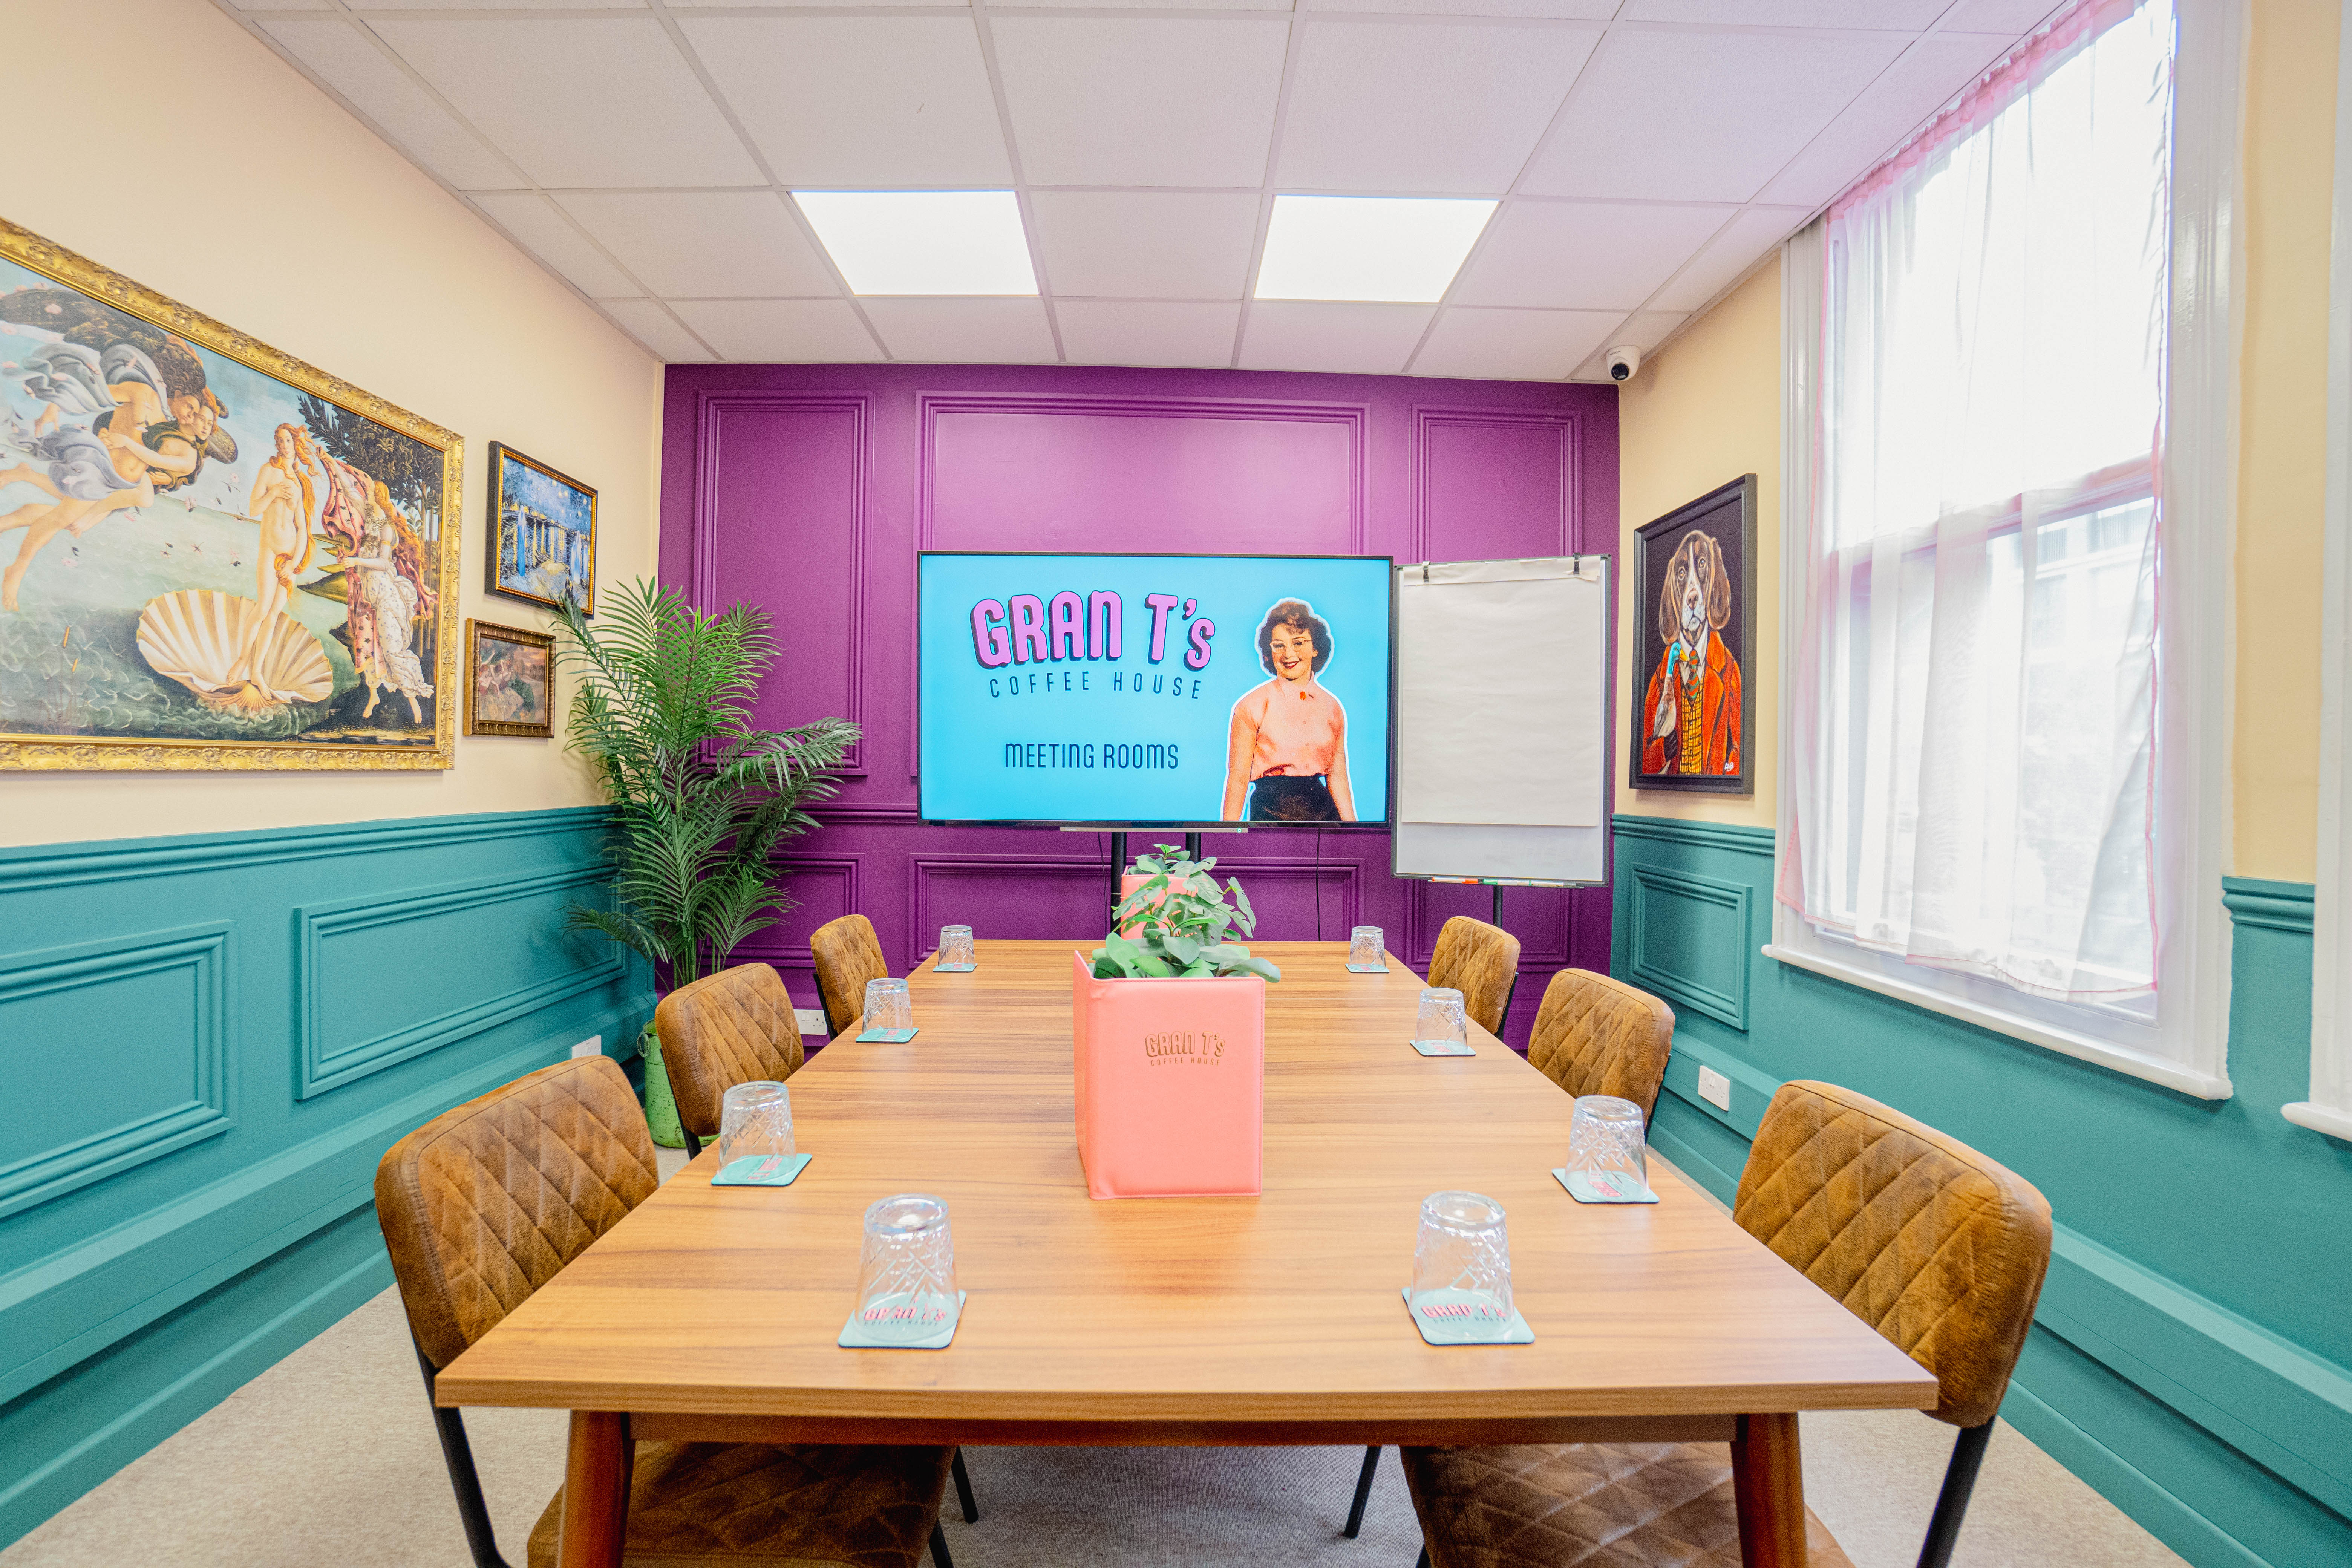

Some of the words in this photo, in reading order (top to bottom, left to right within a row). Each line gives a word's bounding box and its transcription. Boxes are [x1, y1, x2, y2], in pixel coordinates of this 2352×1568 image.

[970, 590, 1122, 670] GRAN
[1144, 593, 1216, 672] T's
[989, 671, 1089, 698] COFFEE
[1113, 672, 1201, 700] HOUSE
[1005, 743, 1095, 769] MEETING
[1104, 743, 1179, 769] ROOMS
[1145, 1031, 1195, 1057] GRAN
[1202, 1031, 1225, 1057] T's
[1150, 1057, 1184, 1066] COFFEE
[1191, 1057, 1220, 1066] HOUSE
